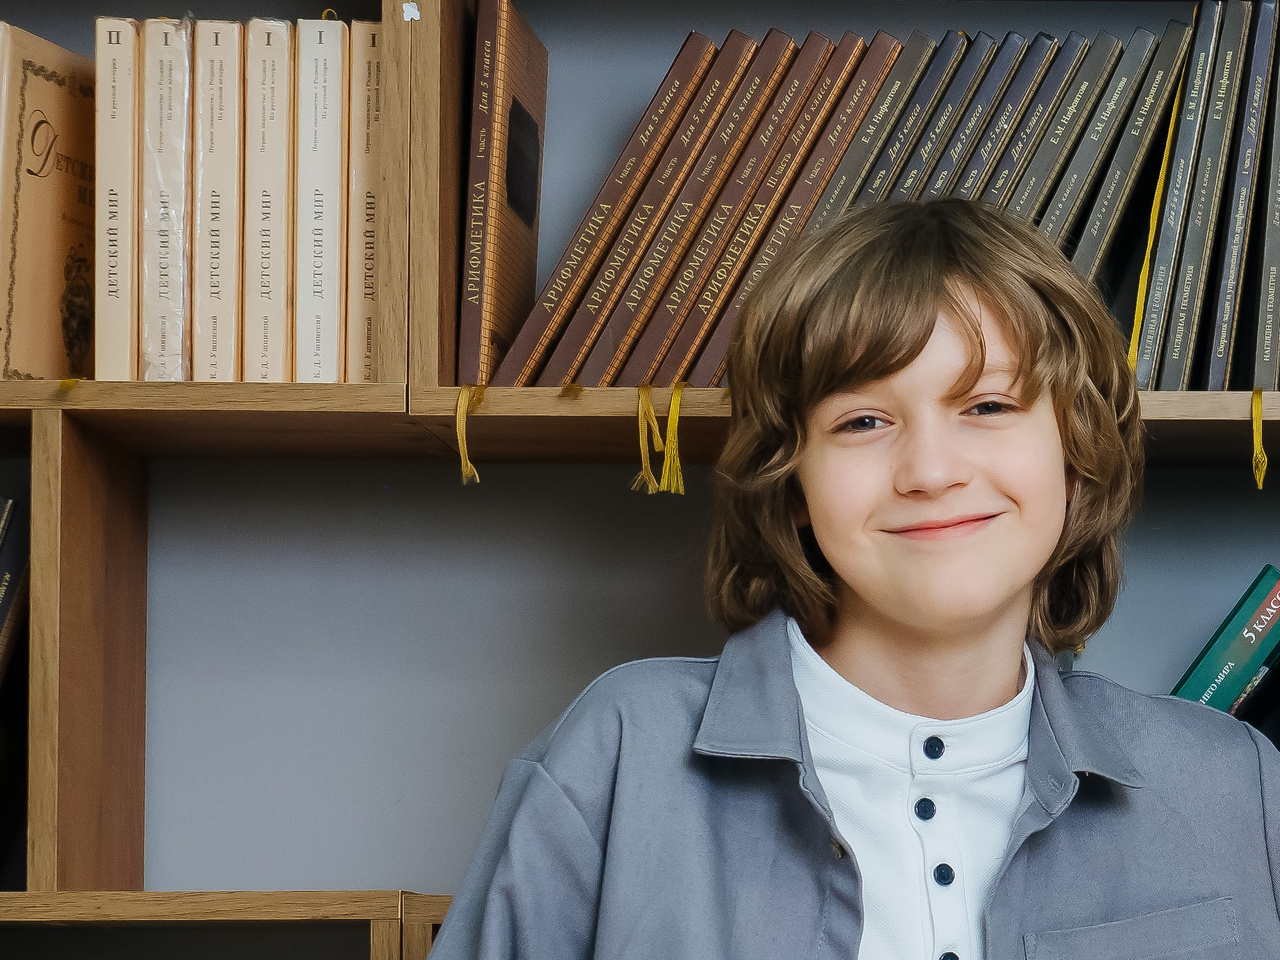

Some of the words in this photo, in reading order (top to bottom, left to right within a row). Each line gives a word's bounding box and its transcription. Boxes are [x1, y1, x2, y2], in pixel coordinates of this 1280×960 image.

[483, 40, 491, 78] класса
[1217, 50, 1233, 97] Нифонтова
[478, 91, 489, 114] Для
[480, 80, 489, 89] 5
[1139, 70, 1164, 115] Нифонтова
[1214, 99, 1224, 110] М.
[1252, 75, 1262, 108] класса
[888, 140, 901, 162] Для
[897, 131, 904, 142] 5
[902, 103, 921, 134] класса
[1130, 128, 1140, 136] Е.
[1134, 116, 1145, 127] М.
[1213, 112, 1222, 120] Е.
[1246, 117, 1258, 139] Для
[1249, 108, 1261, 120] 5
[478, 127, 486, 153] часть
[108, 188, 118, 220] МИР
[159, 190, 170, 221] МИР
[210, 190, 220, 222] МИР
[261, 189, 271, 221] МИР
[313, 188, 324, 221] МИР
[365, 191, 376, 223] МИР
[543, 204, 610, 312] АРИФМЕТИКА
[619, 157, 636, 178] часть
[638, 124, 654, 147] Для
[651, 114, 659, 124] 5
[658, 79, 680, 114] класса
[666, 204, 732, 314] АРИФМЕТИКА
[759, 124, 774, 147] Для
[771, 113, 779, 124] 5
[777, 79, 799, 114] класса
[699, 203, 765, 313] АРИФМЕТИКА
[774, 153, 792, 175] часть
[790, 123, 806, 146] Для
[804, 112, 811, 121] 6
[810, 77, 831, 112] класса
[1234, 187, 1247, 233] арифметике
[106, 227, 119, 298] ДЕТСКИЙ
[467, 181, 485, 304] АРИФМЕТИКА
[587, 205, 653, 313] АРИФМЕТИКА
[626, 202, 693, 311] АРИФМЕТИКА
[157, 229, 169, 300] ДЕТСКИЙ
[209, 229, 221, 300] ДЕТСКИЙ
[259, 228, 272, 300] ДЕТСКИЙ
[311, 228, 324, 299] ДЕТСКИЙ
[364, 229, 376, 301] ДЕТСКИЙ
[1180, 265, 1194, 310] ГЕОМЕТРИЯ
[1266, 266, 1277, 311] ГЕОМЕТРИЯ
[1172, 312, 1186, 359] НАГЛЯДНАЯ
[1216, 323, 1228, 358] Сборник
[1263, 314, 1273, 361] НАГЛЯДНАЯ
[1242, 627, 1256, 644] 5
[1214, 661, 1235, 685] МИРА
